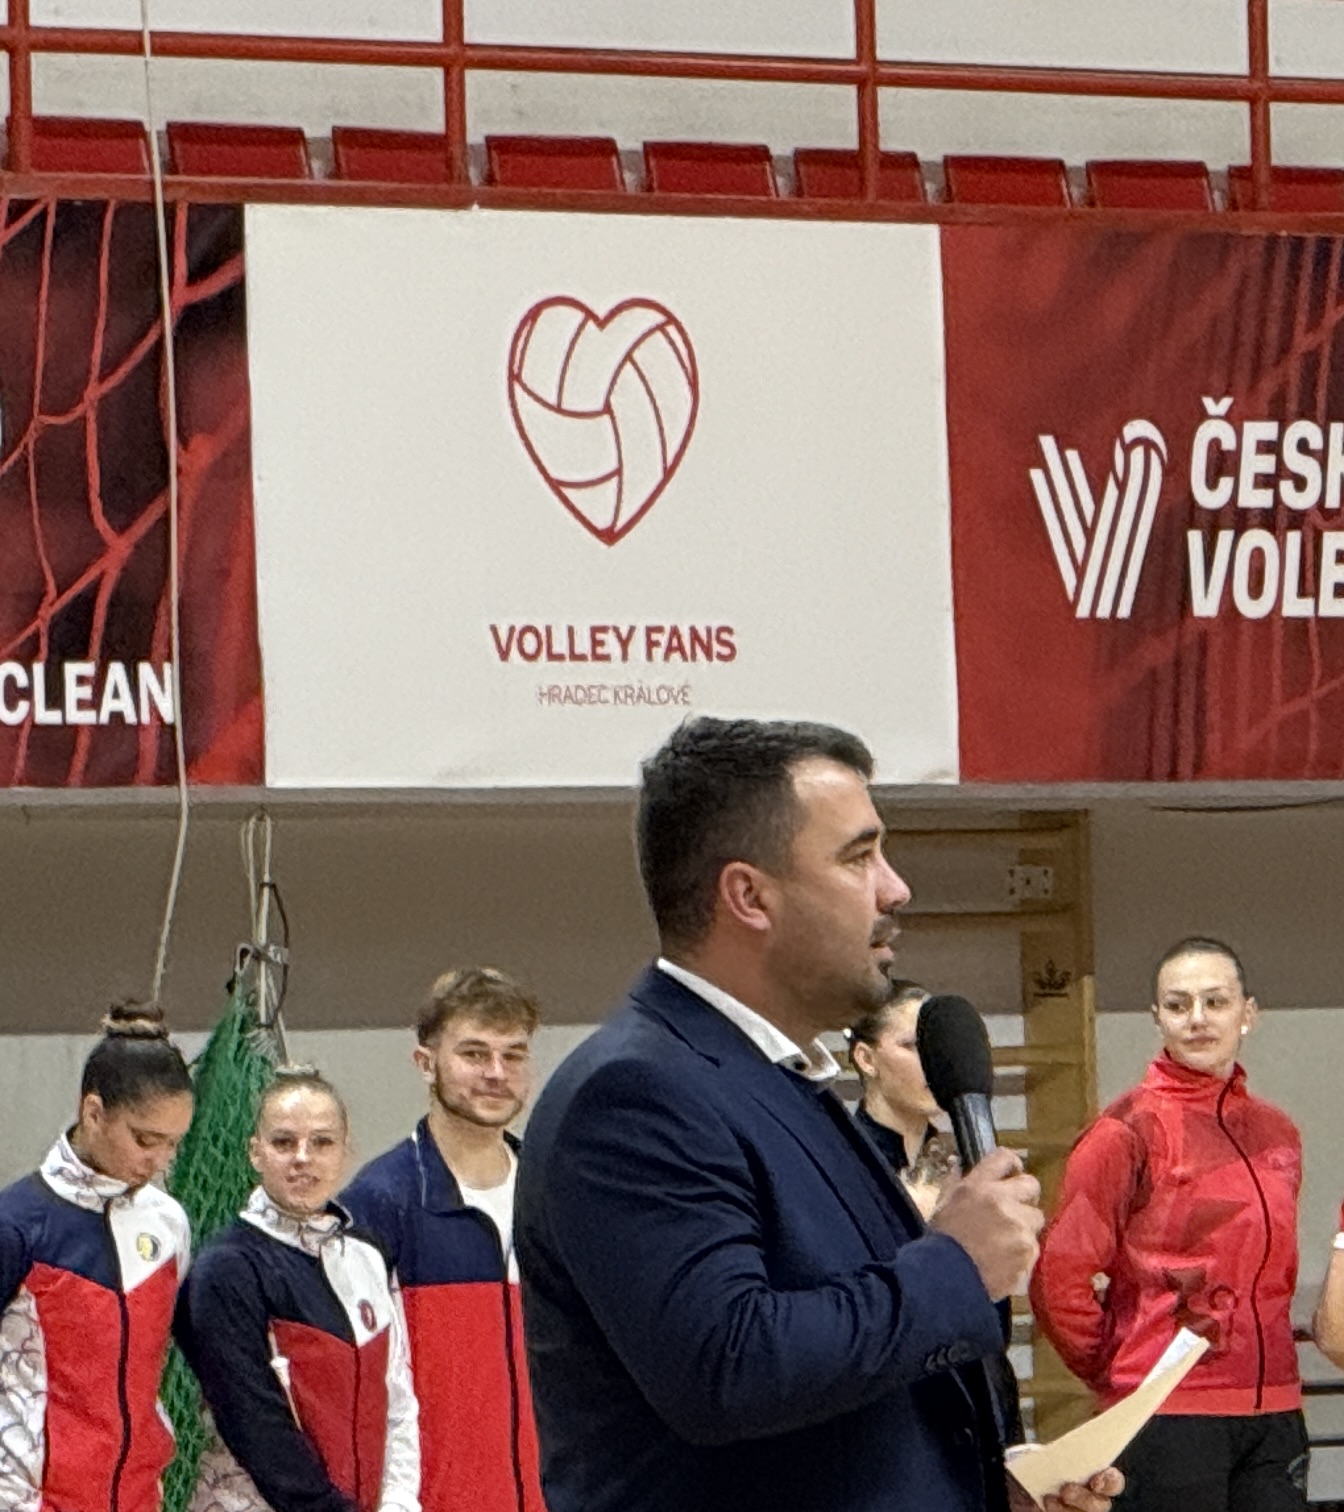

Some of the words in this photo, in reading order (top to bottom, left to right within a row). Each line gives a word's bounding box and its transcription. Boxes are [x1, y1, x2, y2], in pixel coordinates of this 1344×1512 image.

[489, 624, 637, 662] VOLLEY
[645, 624, 737, 662] FANS
[0, 660, 175, 725] CLEAN
[539, 684, 610, 705] HRADEC
[613, 680, 692, 705] KRÁLOVÉ
